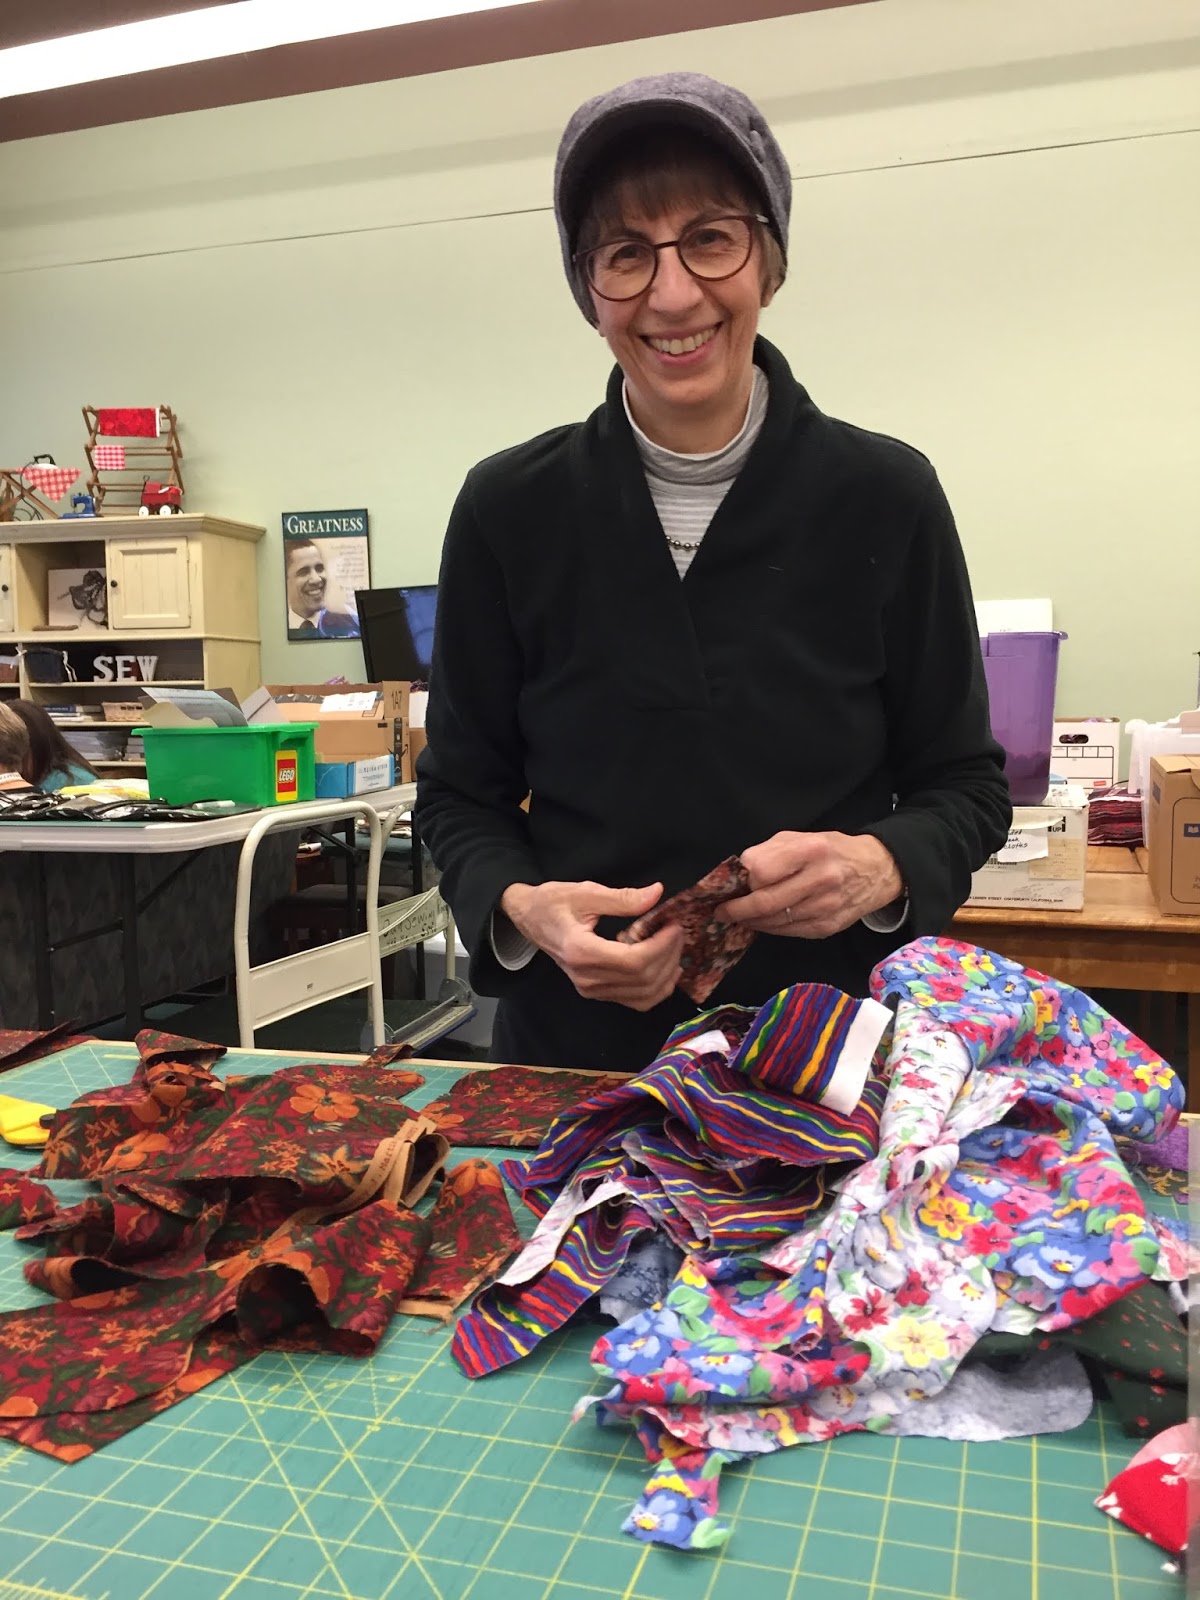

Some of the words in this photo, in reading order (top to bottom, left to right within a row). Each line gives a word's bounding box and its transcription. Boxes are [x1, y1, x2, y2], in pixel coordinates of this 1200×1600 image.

[287, 515, 364, 534] GREATNESS
[93, 655, 158, 682] SEW
[279, 768, 295, 783] LEGO
